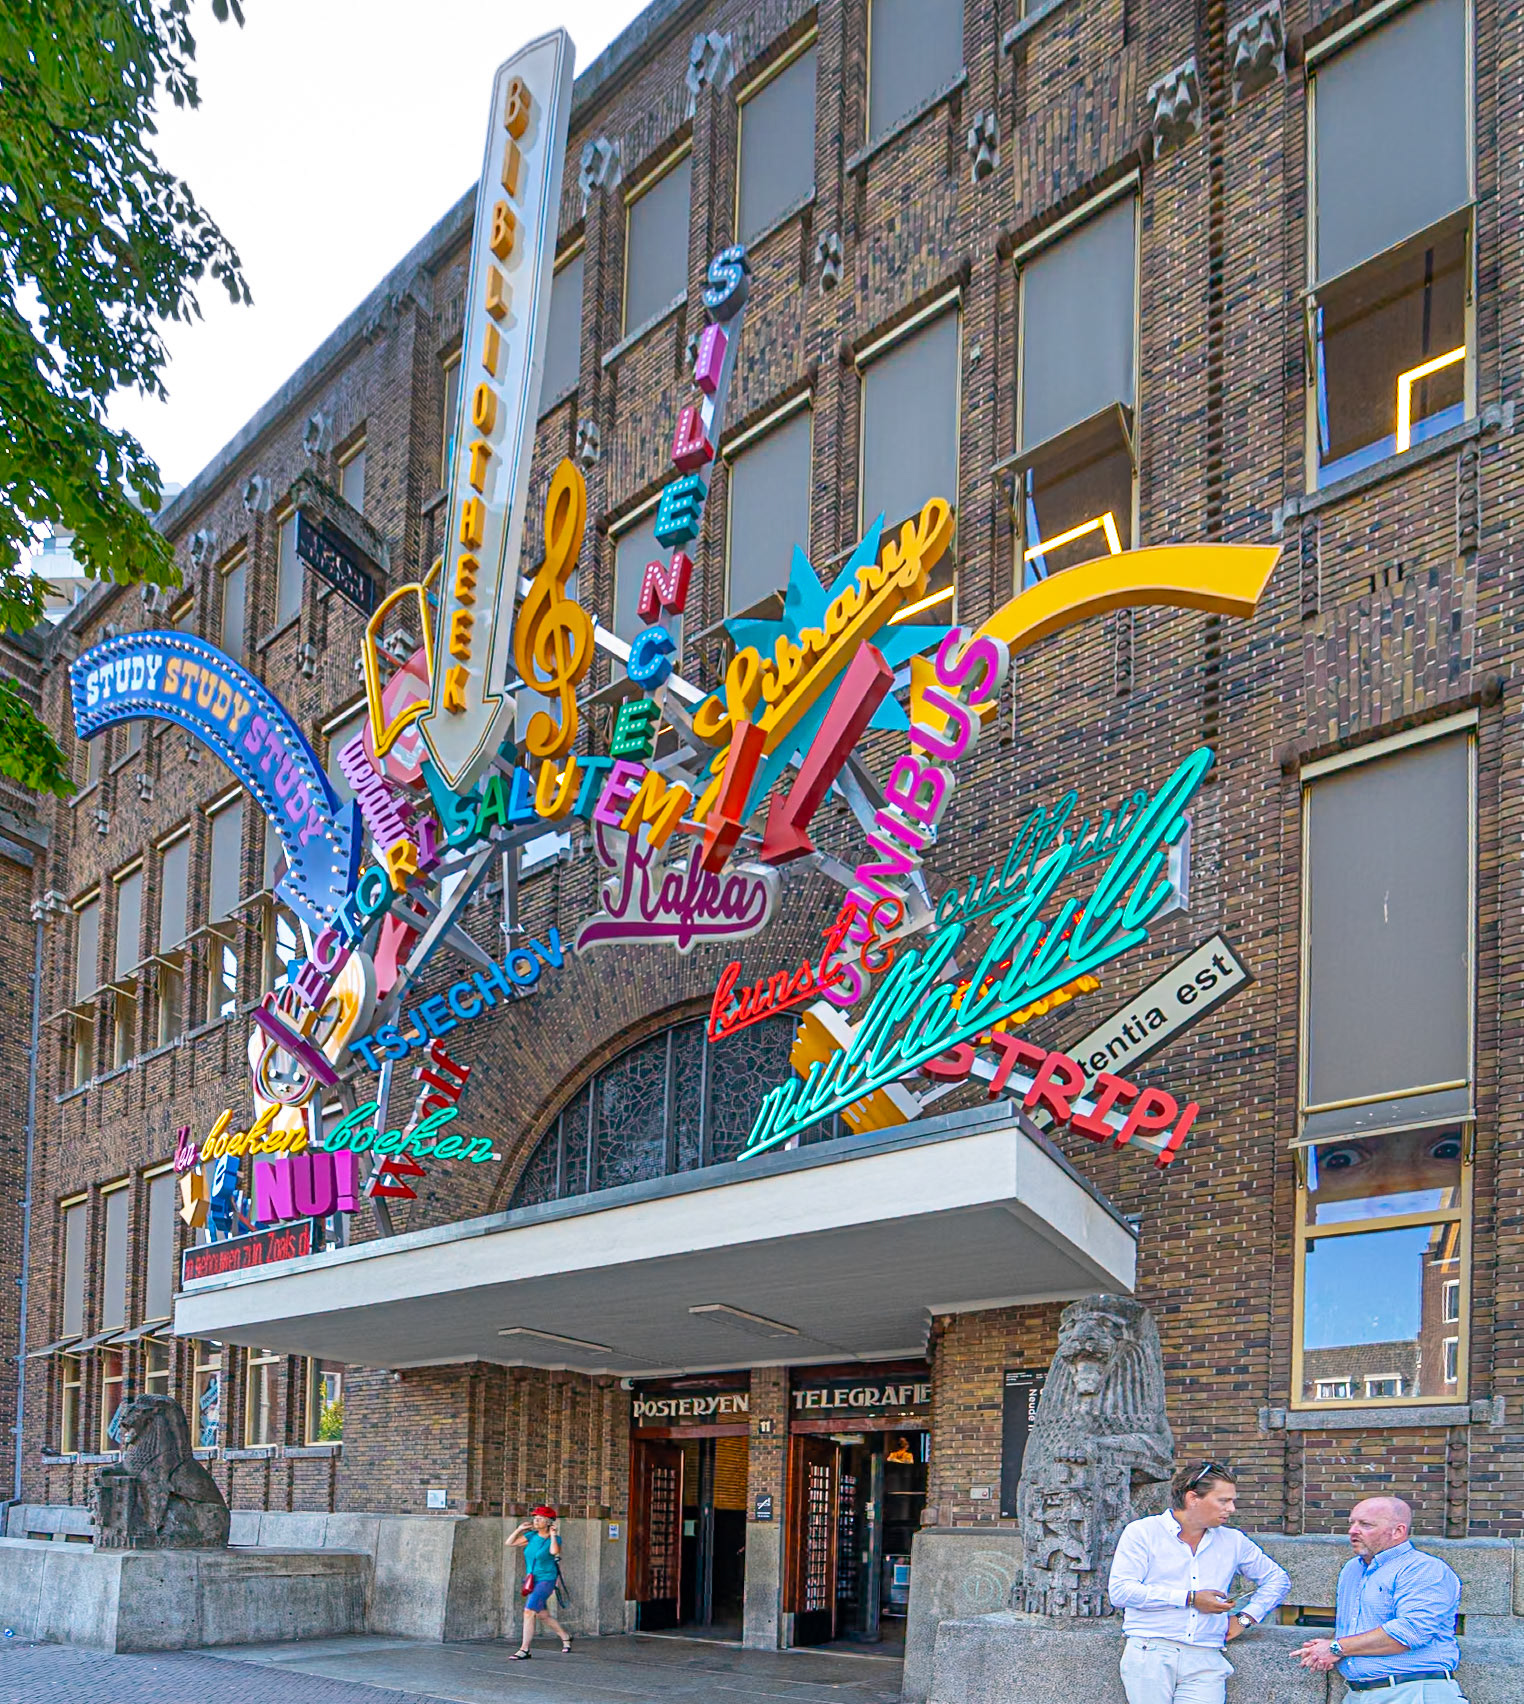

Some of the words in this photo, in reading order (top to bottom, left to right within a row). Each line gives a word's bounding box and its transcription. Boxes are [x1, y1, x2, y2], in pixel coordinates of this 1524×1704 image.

[443, 75, 530, 714] BIBLIOTHEEK
[610, 244, 749, 761] SILENCE
[693, 497, 957, 747] Library
[86, 655, 163, 706] STUDY
[164, 658, 249, 732] STUDY
[243, 715, 324, 847] STUDY
[448, 756, 692, 850] SALUTEM
[578, 822, 767, 949] Kafka
[736, 746, 1214, 1160] multatuli
[350, 928, 565, 1072] TSJECHOV
[708, 902, 858, 1043] kunst
[1076, 1007, 1168, 1080] tentia
[1176, 953, 1233, 1005] est
[200, 1103, 308, 1162] boeken
[323, 1101, 494, 1164] boeken
[370, 1038, 471, 1199] Wolf
[920, 1031, 1200, 1169] STRIP!
[254, 1149, 360, 1224] NU!
[633, 1392, 750, 1418] POSTERYEN
[792, 1383, 932, 1409] TELEGRAFIE
[1028, 1387, 1038, 1421] Neude
